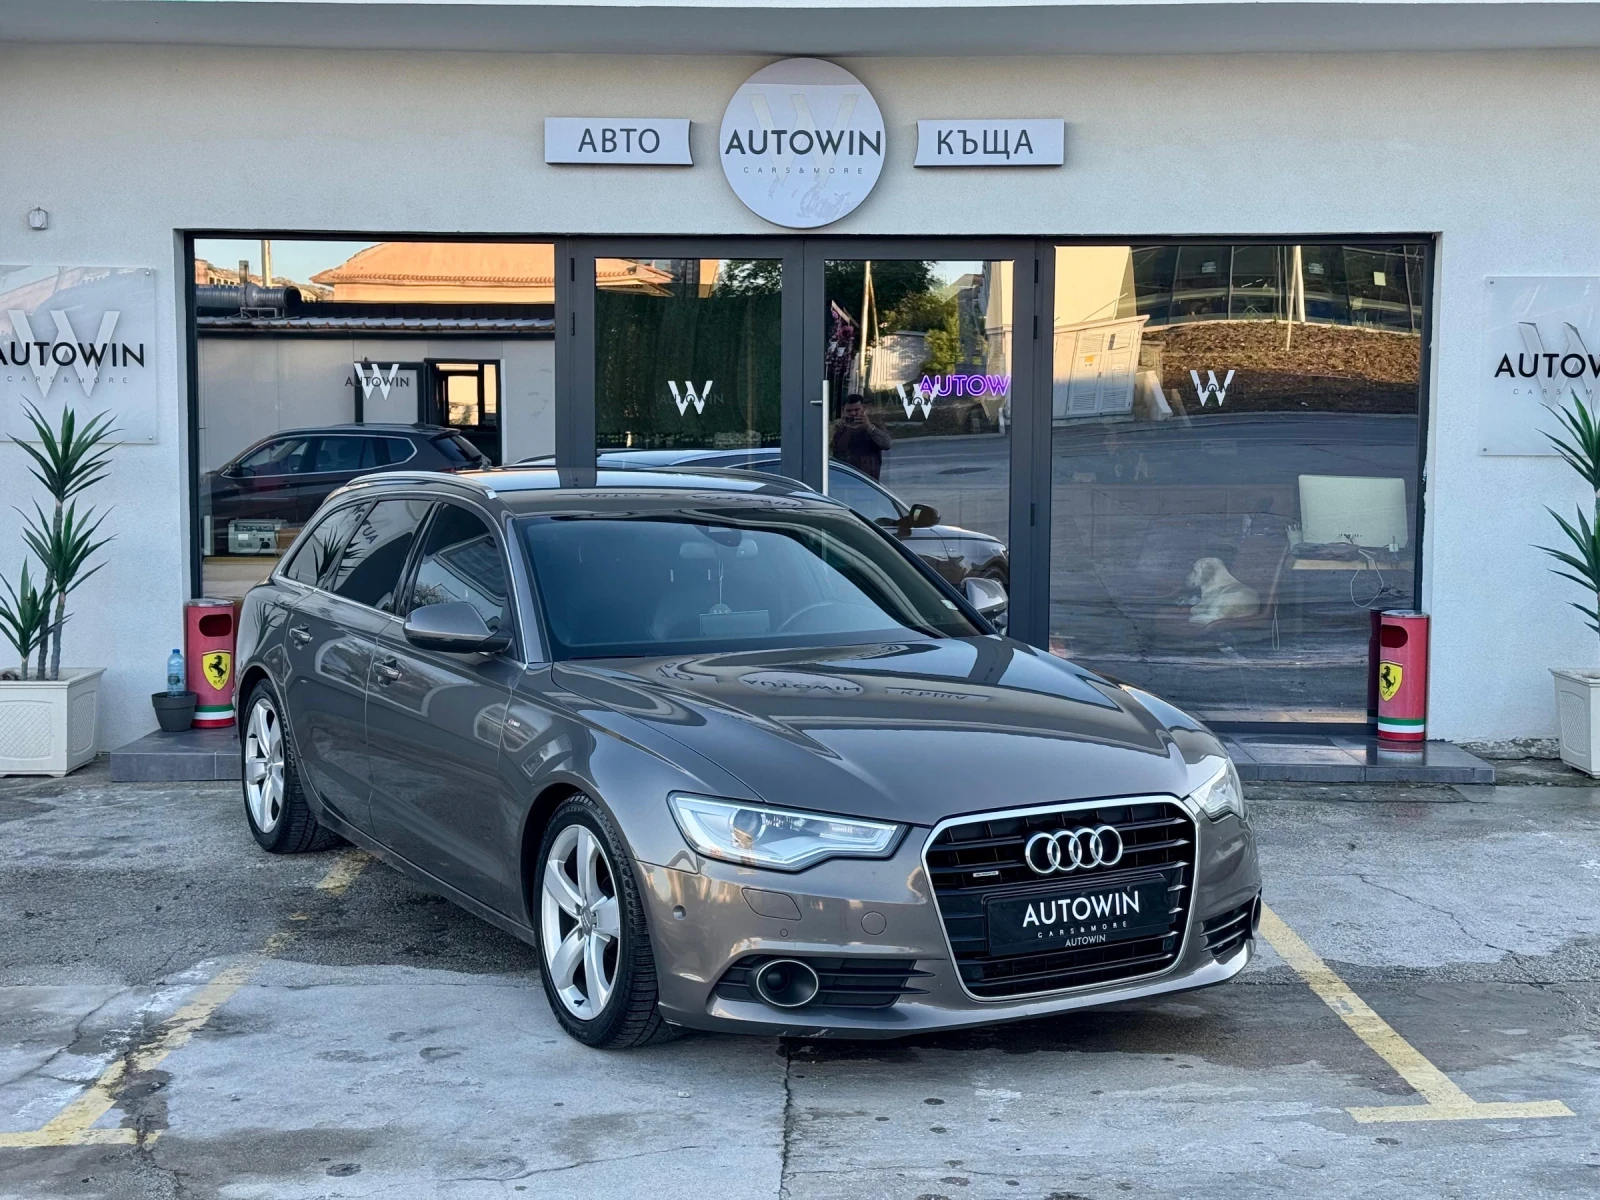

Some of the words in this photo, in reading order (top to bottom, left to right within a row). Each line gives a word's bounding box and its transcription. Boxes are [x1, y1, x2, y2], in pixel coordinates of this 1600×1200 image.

[577, 127, 661, 154] АВТО
[724, 129, 881, 156] AUTOWIN
[937, 129, 1034, 160] КЪЩА
[919, 374, 1012, 397] AUTOW
[1022, 890, 1140, 928] AUTOWIN
[1037, 921, 1127, 938] CARS&MORE
[1064, 934, 1106, 948] AUTOWIN
